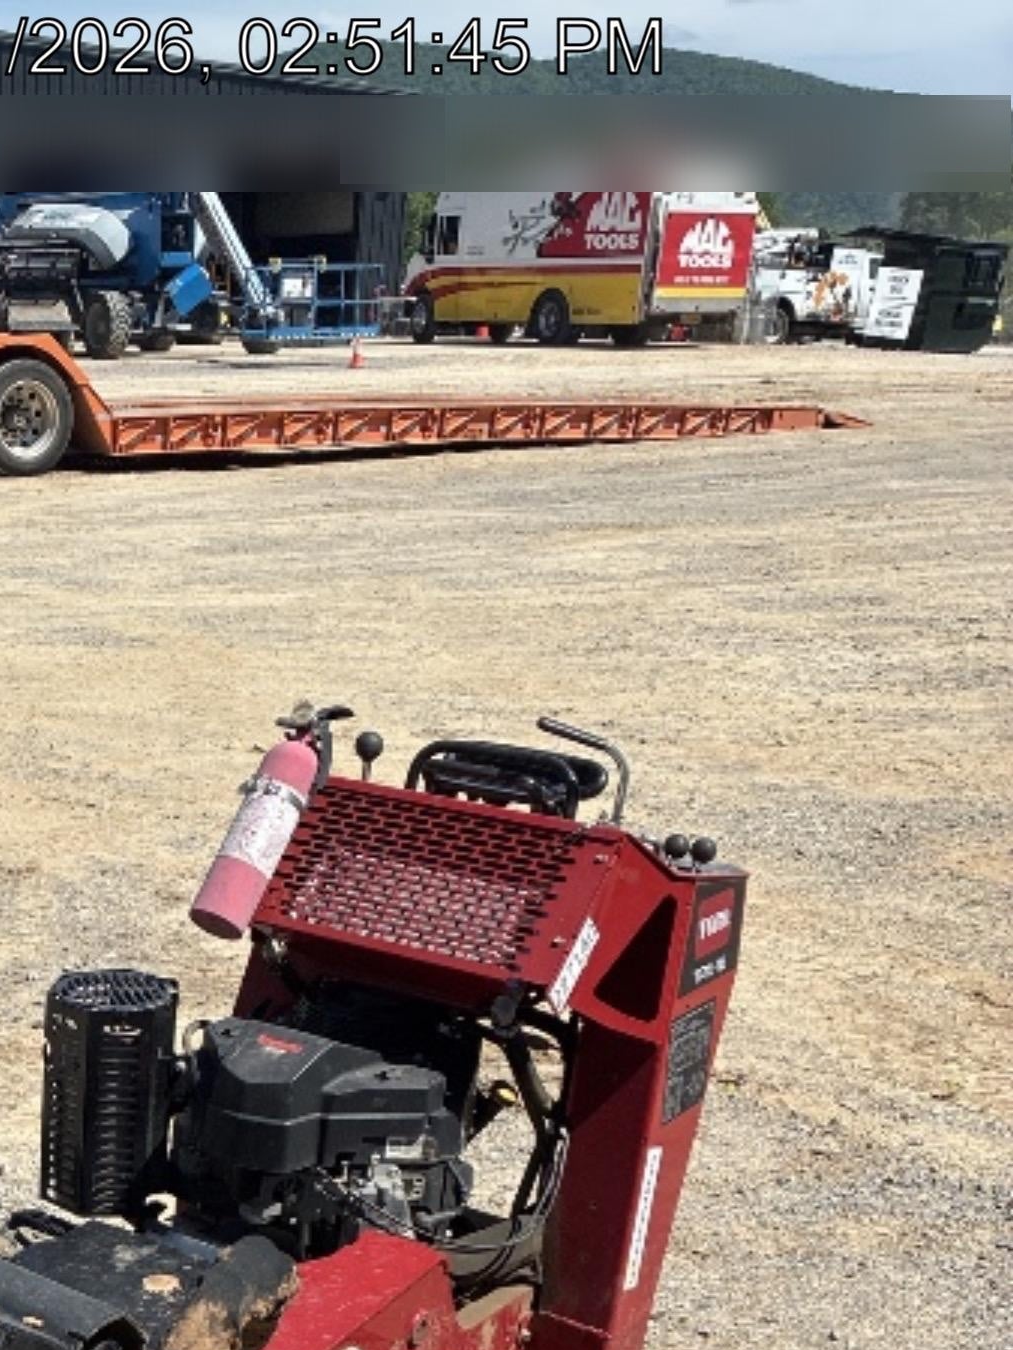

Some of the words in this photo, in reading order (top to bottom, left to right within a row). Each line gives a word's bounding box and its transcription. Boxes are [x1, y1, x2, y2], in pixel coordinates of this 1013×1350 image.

[584, 233, 639, 250] TOOLS
[679, 217, 735, 254] MAC
[677, 253, 732, 268] TOOLS
